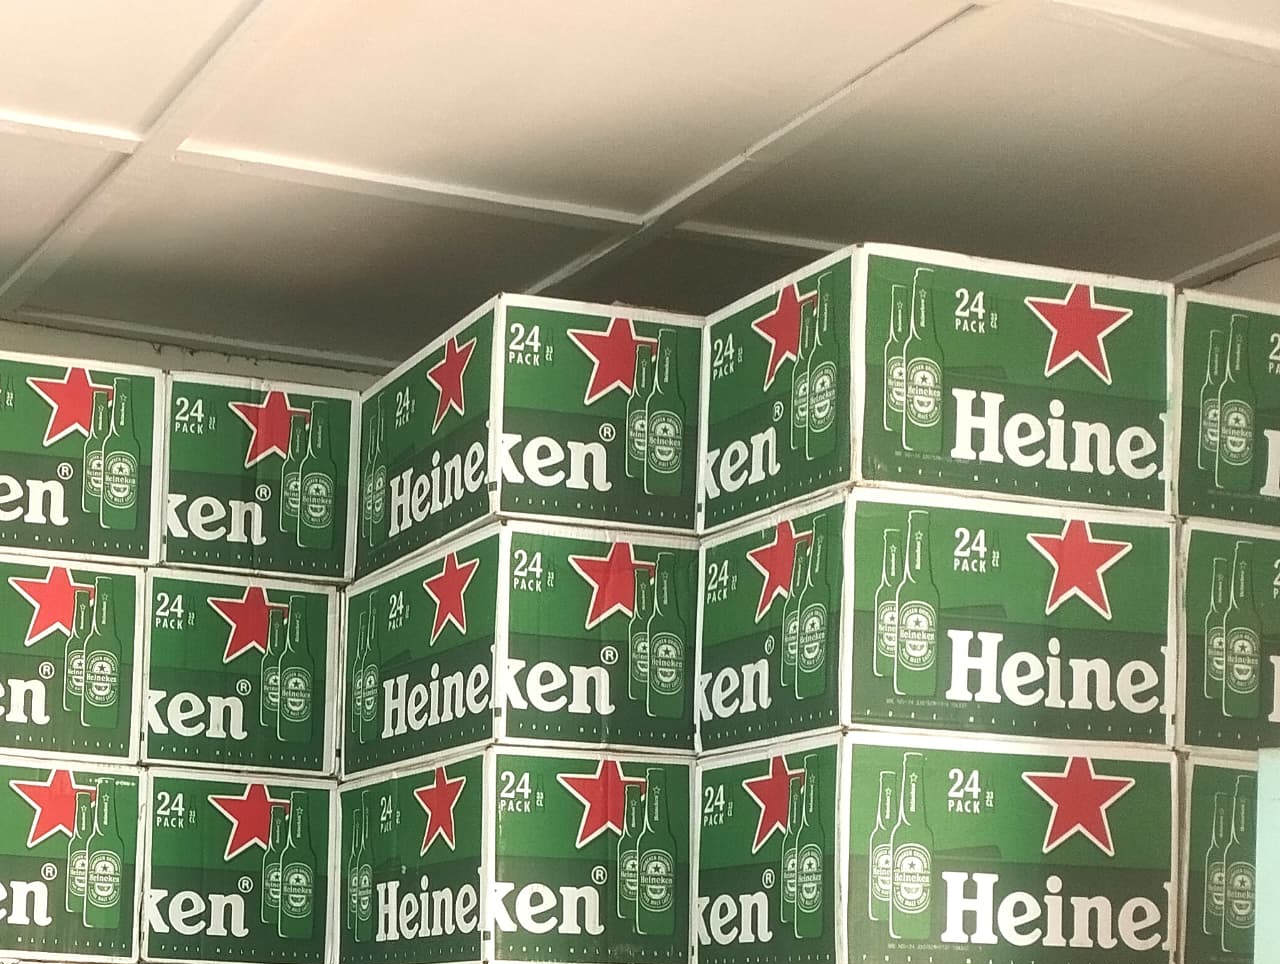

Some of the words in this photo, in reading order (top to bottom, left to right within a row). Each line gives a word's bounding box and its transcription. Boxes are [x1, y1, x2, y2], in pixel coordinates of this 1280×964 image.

[955, 288, 985, 319] 24
[509, 323, 541, 352] 24
[714, 334, 734, 367] 24
[176, 397, 204, 422] 24
[950, 387, 1169, 480] Heine
[388, 420, 494, 538] Heine
[954, 528, 987, 558] 24
[514, 550, 543, 578] 24
[945, 629, 1174, 714] Heine
[381, 648, 494, 739] Heine
[500, 771, 531, 799] 24
[704, 785, 725, 813] 24
[157, 792, 184, 816] 24
[376, 874, 482, 942] Heine
[941, 871, 1172, 951] Heine
